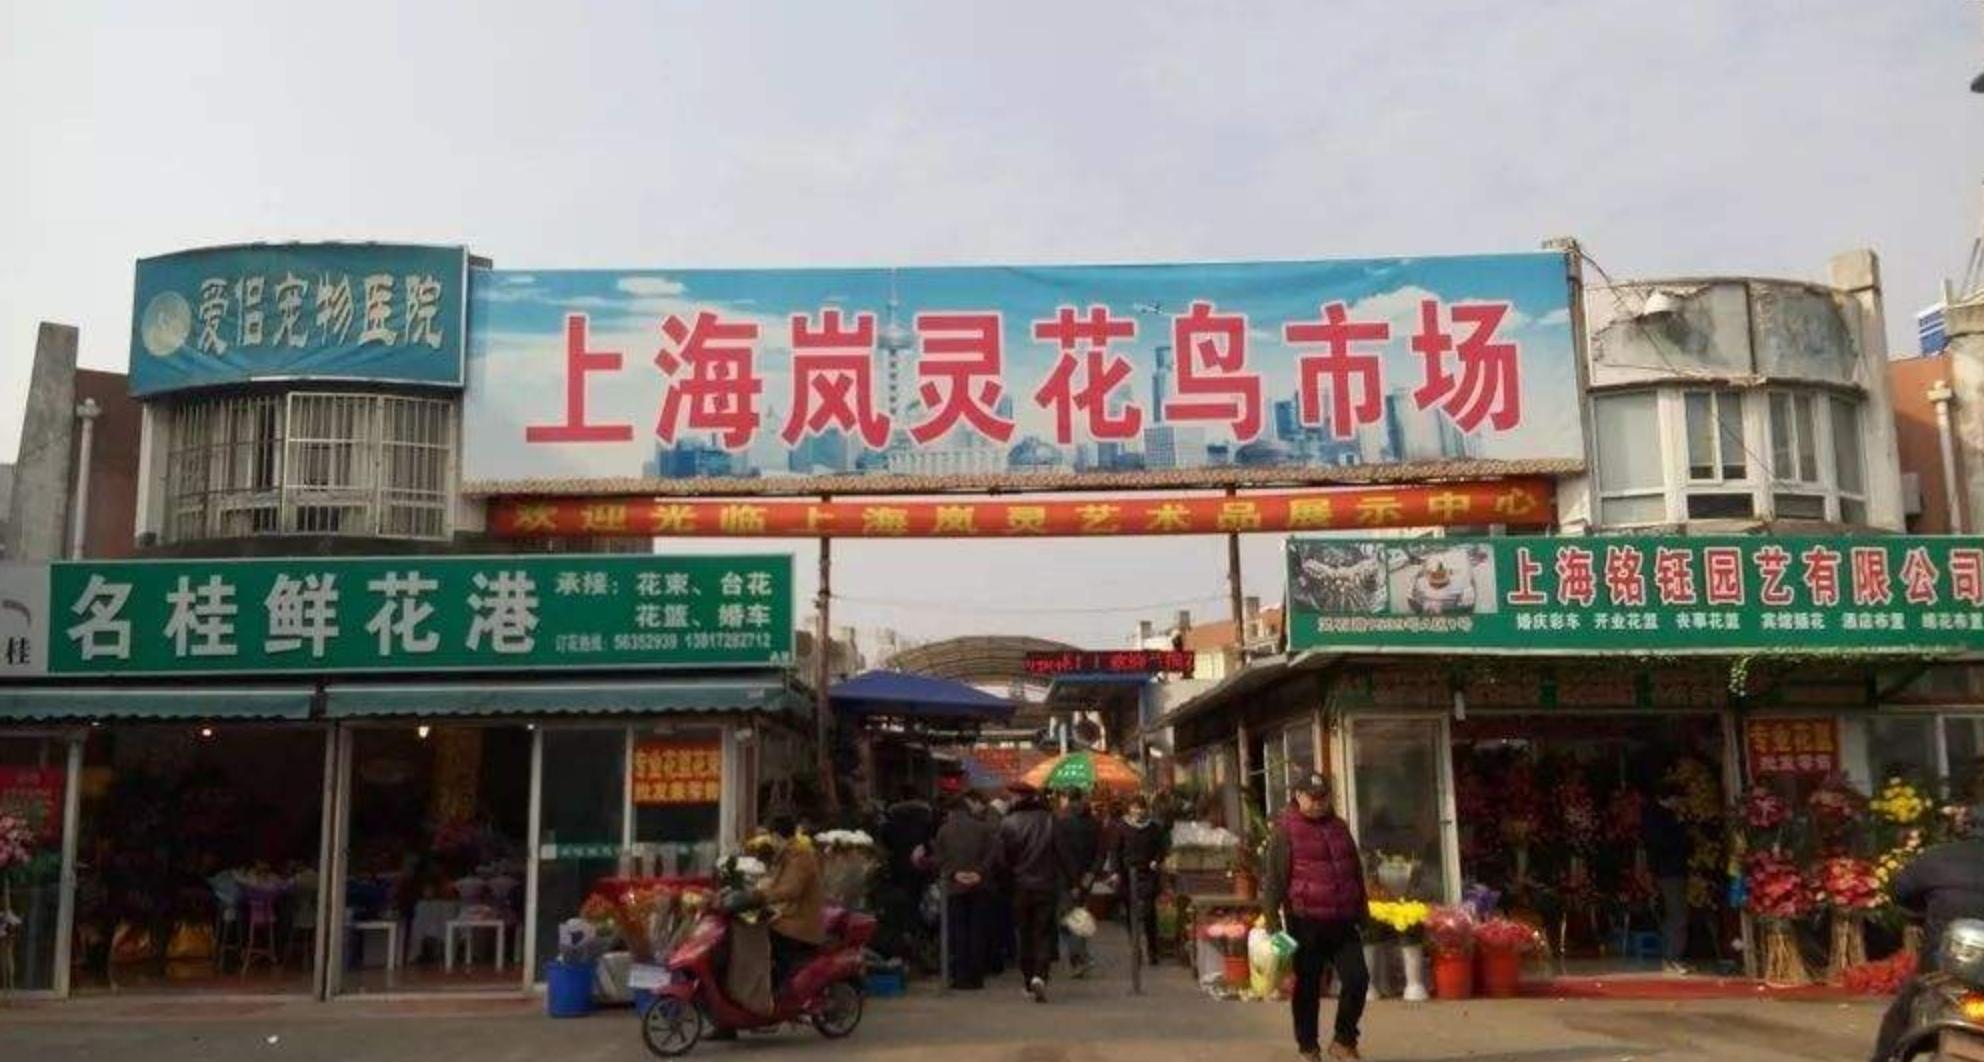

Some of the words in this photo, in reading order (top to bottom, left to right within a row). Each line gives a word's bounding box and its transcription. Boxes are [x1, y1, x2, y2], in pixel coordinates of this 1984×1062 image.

[198, 272, 443, 354] 爱侣宠物医院
[524, 298, 1524, 453] 上海岚灵花鸟市场
[513, 488, 1538, 536] 欢迎光临上海岚灵艺术品展示中心
[1507, 545, 1984, 608] 上海铭钰园艺有限公司
[66, 572, 541, 661] 名桂鲜花港
[1594, 612, 1659, 630] 开业花篮
